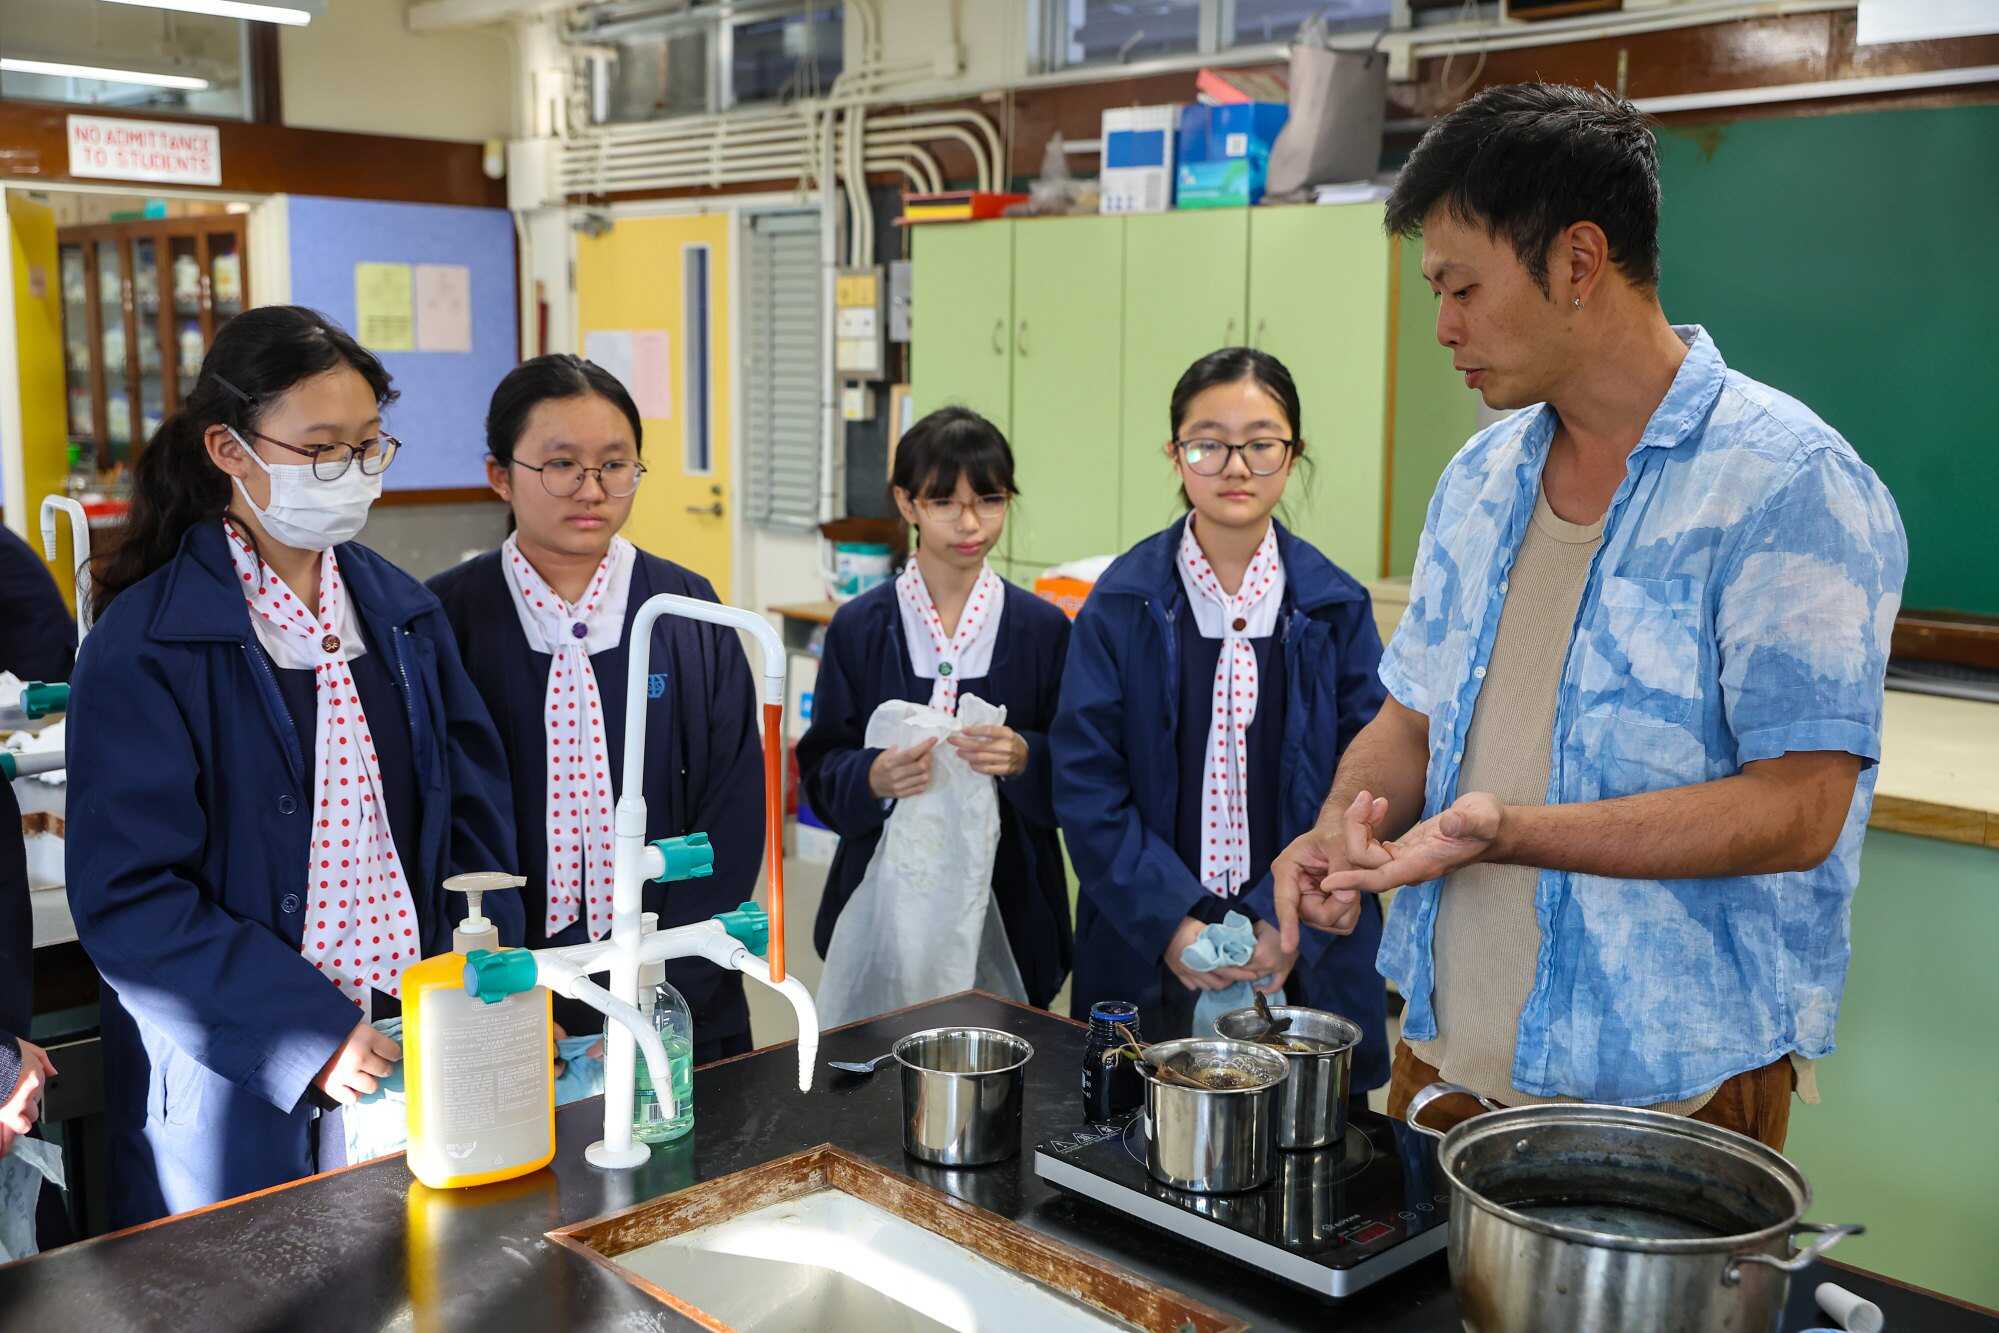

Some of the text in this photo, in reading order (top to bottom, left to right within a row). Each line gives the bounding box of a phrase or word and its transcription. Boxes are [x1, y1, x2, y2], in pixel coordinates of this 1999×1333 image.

[75, 124, 209, 151] NO ADMITTANCE
[84, 146, 212, 174] TO STUDENTS
